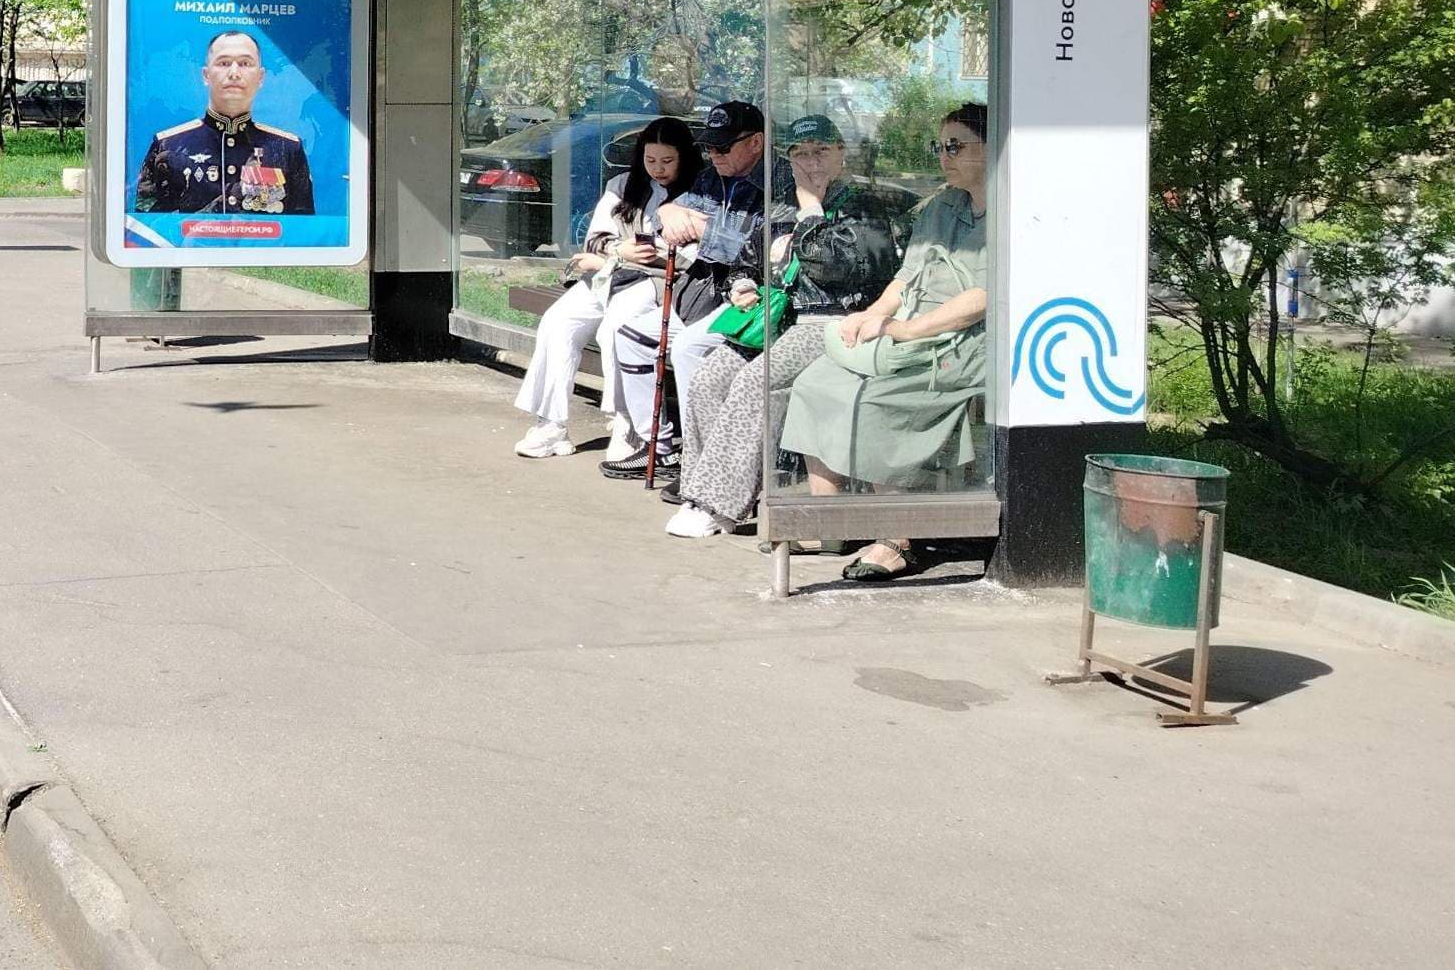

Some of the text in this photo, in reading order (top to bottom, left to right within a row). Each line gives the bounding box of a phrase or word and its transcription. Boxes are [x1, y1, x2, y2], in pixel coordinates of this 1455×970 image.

[174, 0, 297, 17] МИХАИЛ МАРЦЕВ
[199, 15, 272, 26] ПОДПОЛКОВНИК
